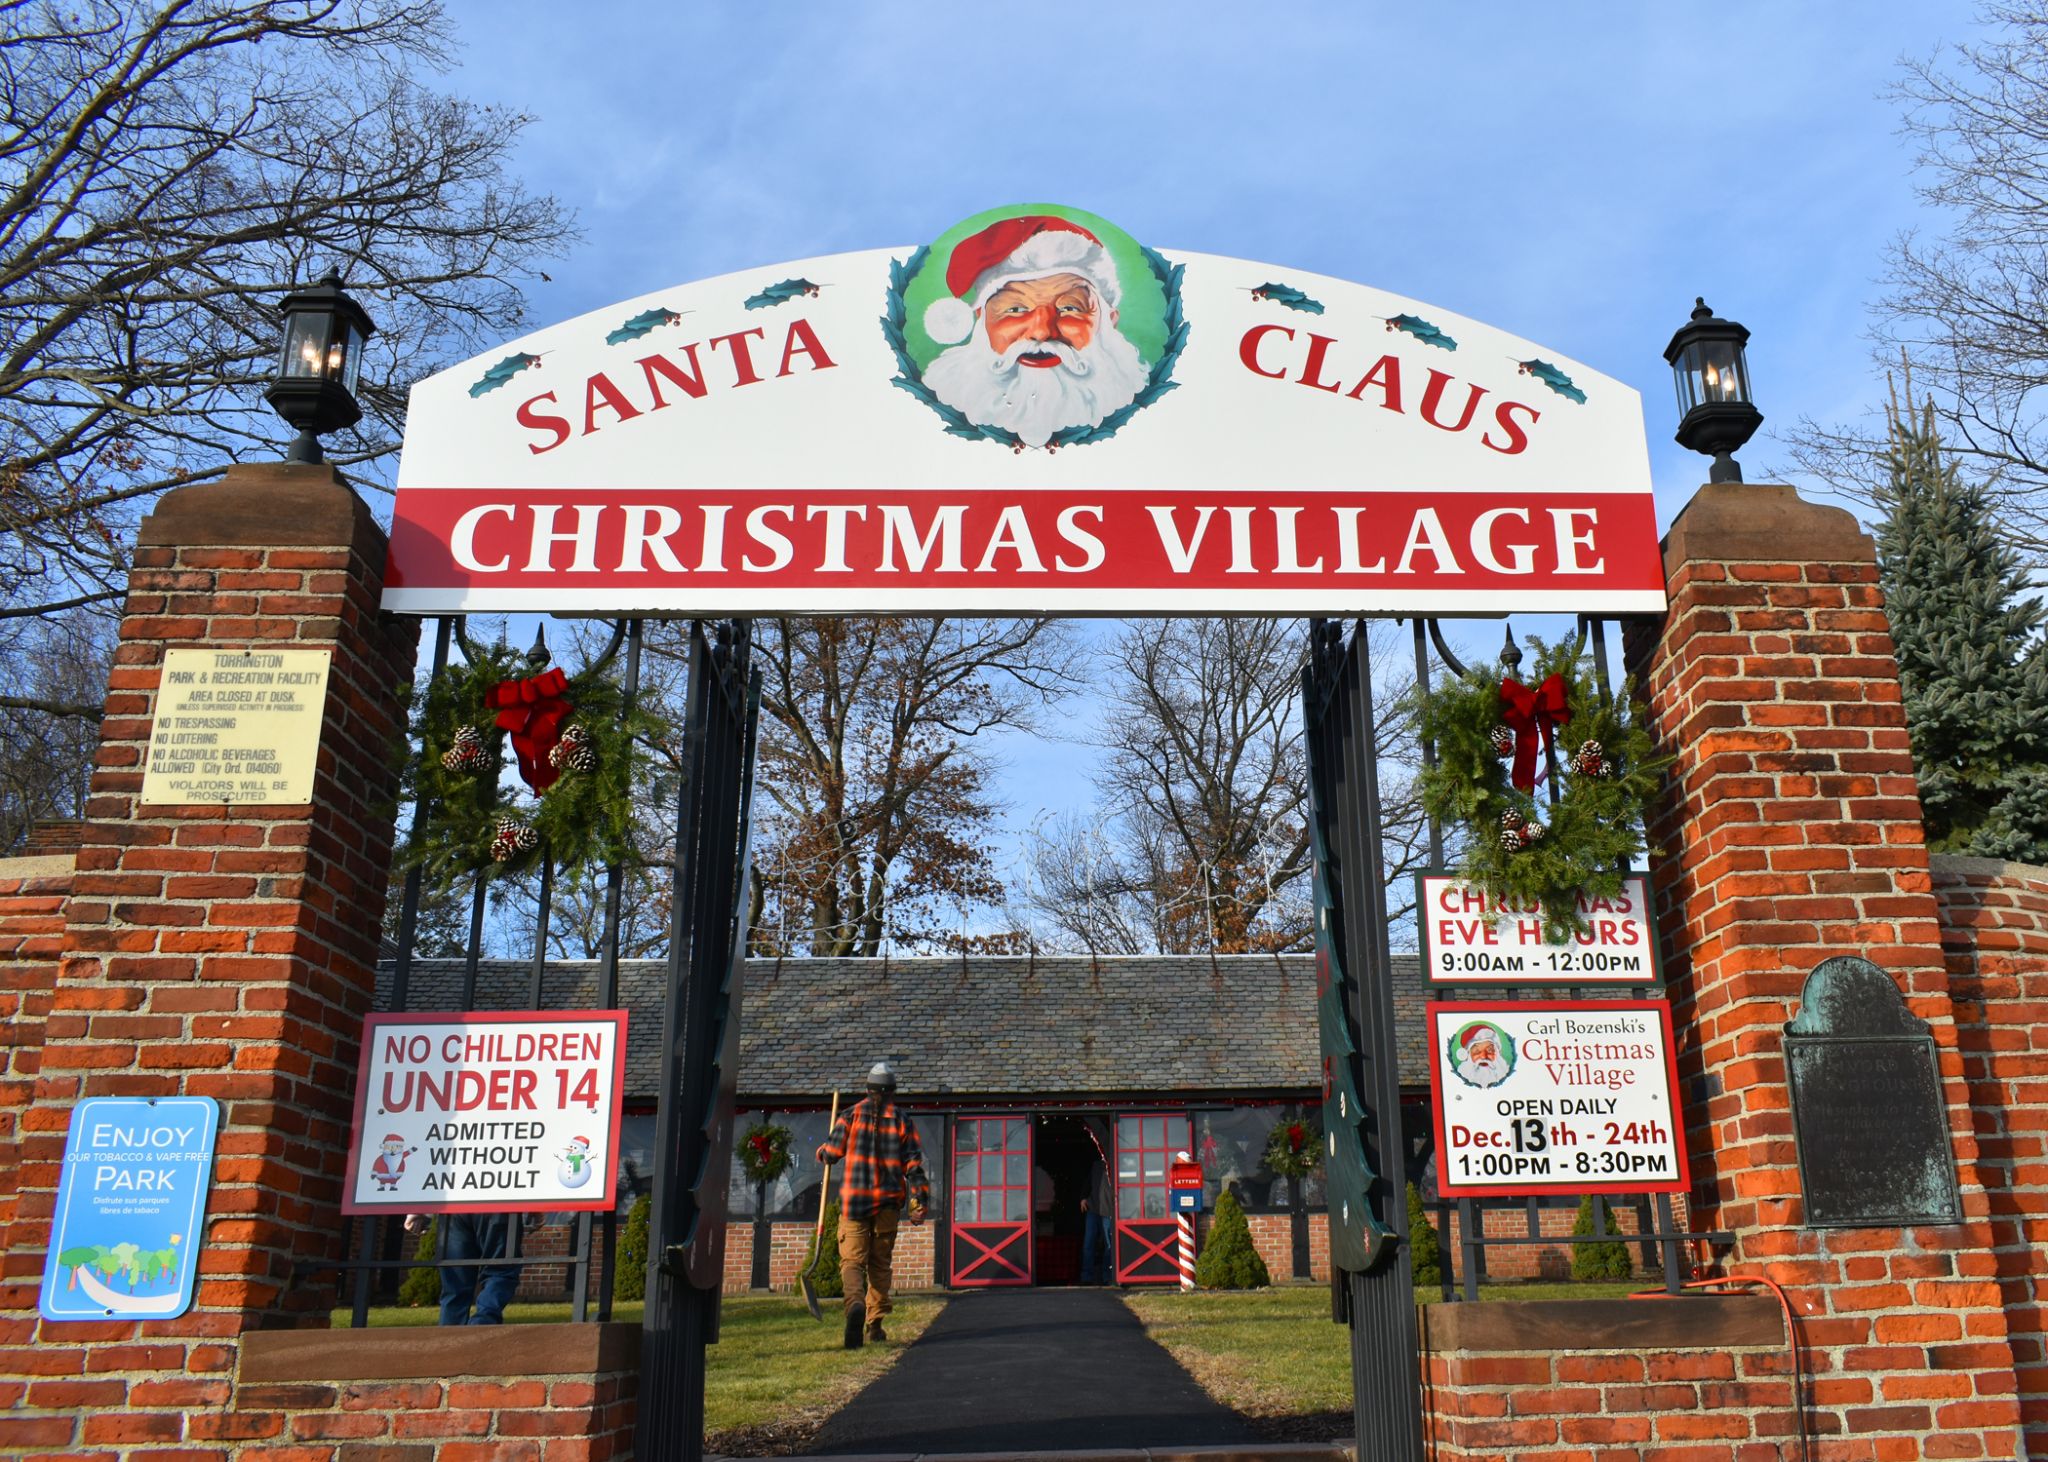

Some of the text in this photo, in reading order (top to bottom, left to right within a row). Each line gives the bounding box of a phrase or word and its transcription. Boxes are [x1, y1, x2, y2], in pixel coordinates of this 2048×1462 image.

[516, 318, 1541, 456] SANTA CLAUS
[450, 504, 1605, 576] CHRISTMAS VILLAGE
[214, 655, 283, 668] TORRINGTON
[168, 672, 321, 685] PARK & RECREATION FACILITY
[188, 691, 295, 702] AREA CLOSED AT DUSK
[158, 717, 237, 729] NO TRESPASSING
[155, 733, 218, 745] NO LOITERING
[152, 749, 276, 760] NO ALCOHOLIC BEVERAGES
[151, 762, 195, 773] ALLOWED
[169, 781, 288, 790] VIOLATORS WILL BE
[186, 791, 267, 801] PROSECUTED
[1439, 888, 1632, 914] CHRISMAS
[1440, 919, 1640, 945] EVE HURS
[1442, 952, 1524, 971] 9:00AM
[1547, 952, 1640, 971] 12:00PM
[1527, 1018, 1646, 1035] Carl Bozenski's
[384, 1032, 602, 1064] NO CHILDREN
[1522, 1039, 1655, 1061] Christmas
[1545, 1063, 1636, 1090] Village
[382, 1068, 600, 1113] UNDER 14
[1497, 1098, 1618, 1116] OPEN DAILY
[91, 1124, 194, 1147] ENJOY
[425, 1122, 545, 1141] ADMITTED
[1604, 1120, 1667, 1145] 24th
[67, 1152, 209, 1162] OUR TOBACCO & VAPE FREE
[430, 1146, 538, 1165] WITHOUT
[1458, 1154, 1550, 1176] 1:00PM
[1576, 1151, 1667, 1174] 8:30PM
[94, 1166, 176, 1191] PARK
[422, 1170, 540, 1190] AN ADULT
[93, 1196, 123, 1204] Disfrute
[100, 1206, 120, 1214] libres
[134, 1206, 160, 1214] tabaco
